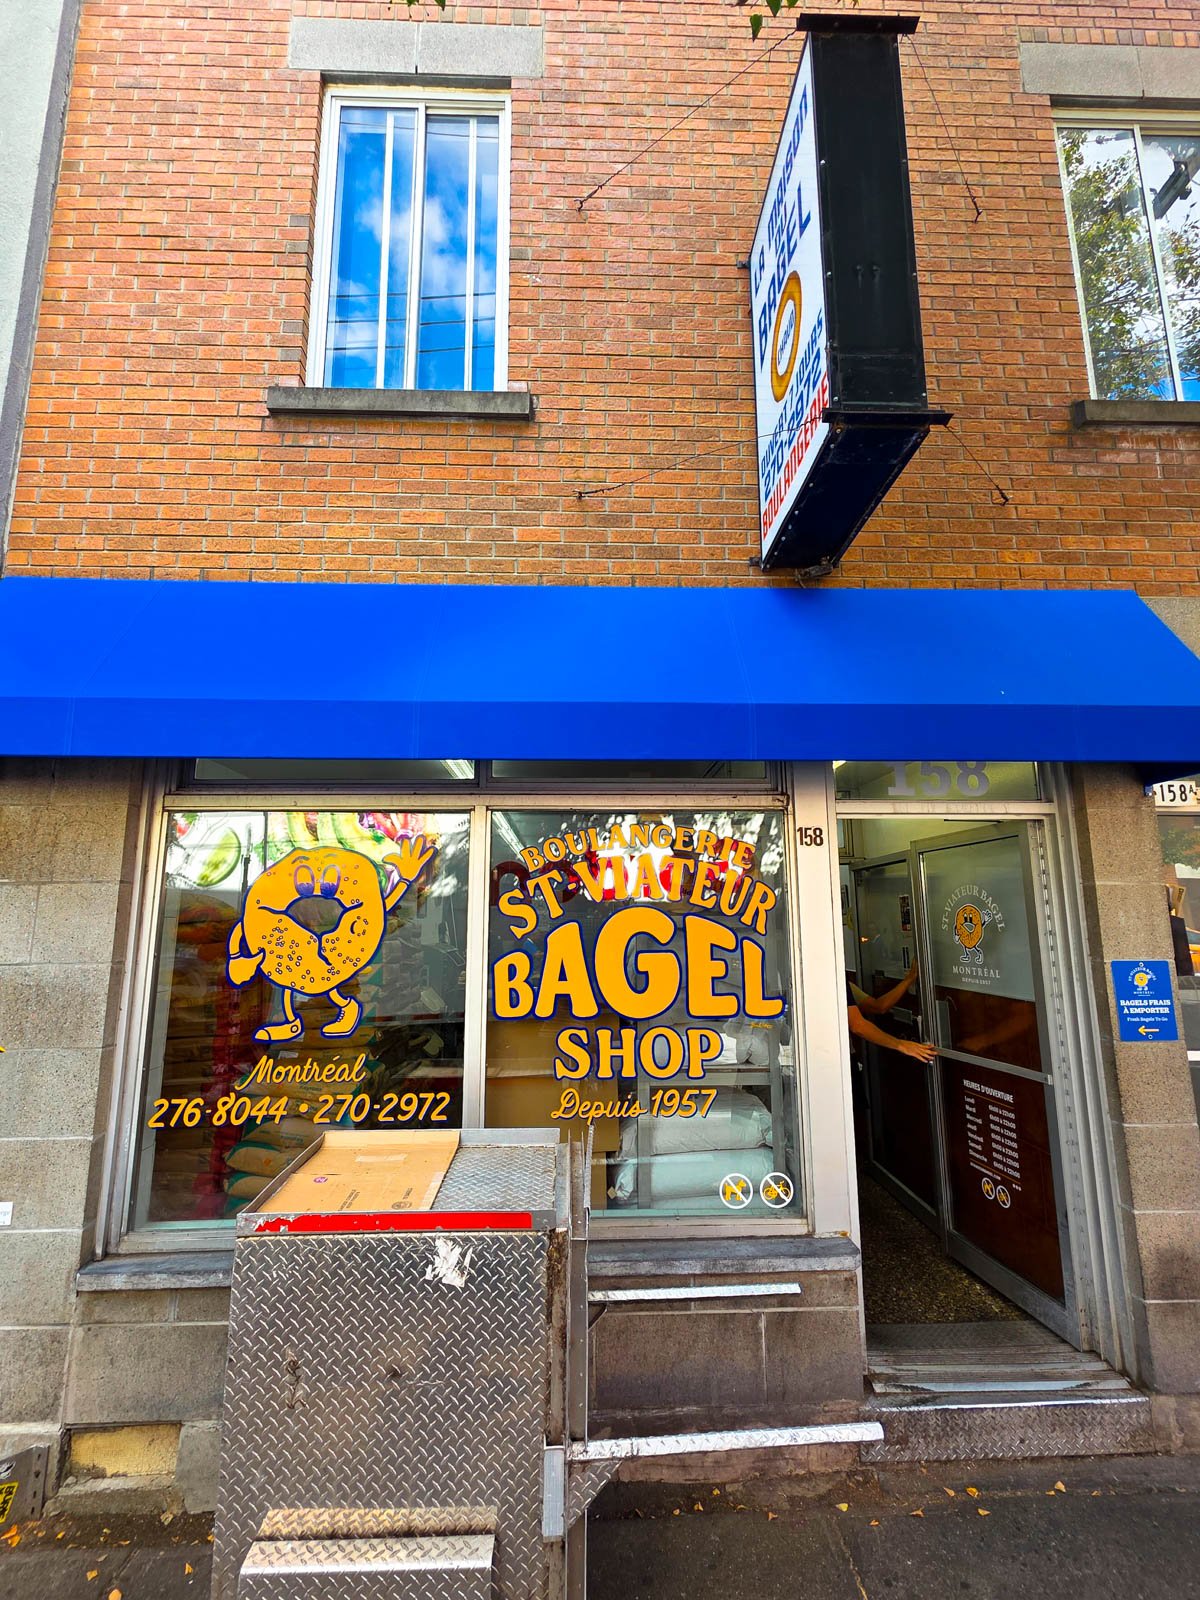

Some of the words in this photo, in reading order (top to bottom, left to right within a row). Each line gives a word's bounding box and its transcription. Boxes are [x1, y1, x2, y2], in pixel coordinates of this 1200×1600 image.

[754, 245, 765, 298] LA
[758, 180, 811, 373] BAGEL
[777, 309, 795, 367] CHAUD
[761, 400, 788, 479] OUVERT
[795, 307, 823, 397] JOURS
[764, 346, 822, 502] 270-2972
[762, 371, 829, 541] BOULANGERIE
[520, 823, 756, 873] BOULANGERIE
[797, 826, 824, 847] 158
[497, 852, 777, 940] ST-VIATEUR
[942, 884, 979, 931] ST-VIATEUR
[980, 889, 1006, 932] BAGEL
[491, 904, 789, 1021] BAGEL
[952, 964, 1001, 979] MONTRÉAL
[1123, 1006, 1129, 1014] À
[234, 1053, 367, 1091] Montréal
[553, 1025, 724, 1080] SHOP
[147, 1091, 291, 1130] 276-8044
[313, 1092, 452, 1125] 270-2972
[551, 1087, 647, 1128] Depuis
[651, 1088, 718, 1119] 1957
[963, 1079, 980, 1091] HEURES
[981, 1085, 1014, 1103] D'OUVERTURE
